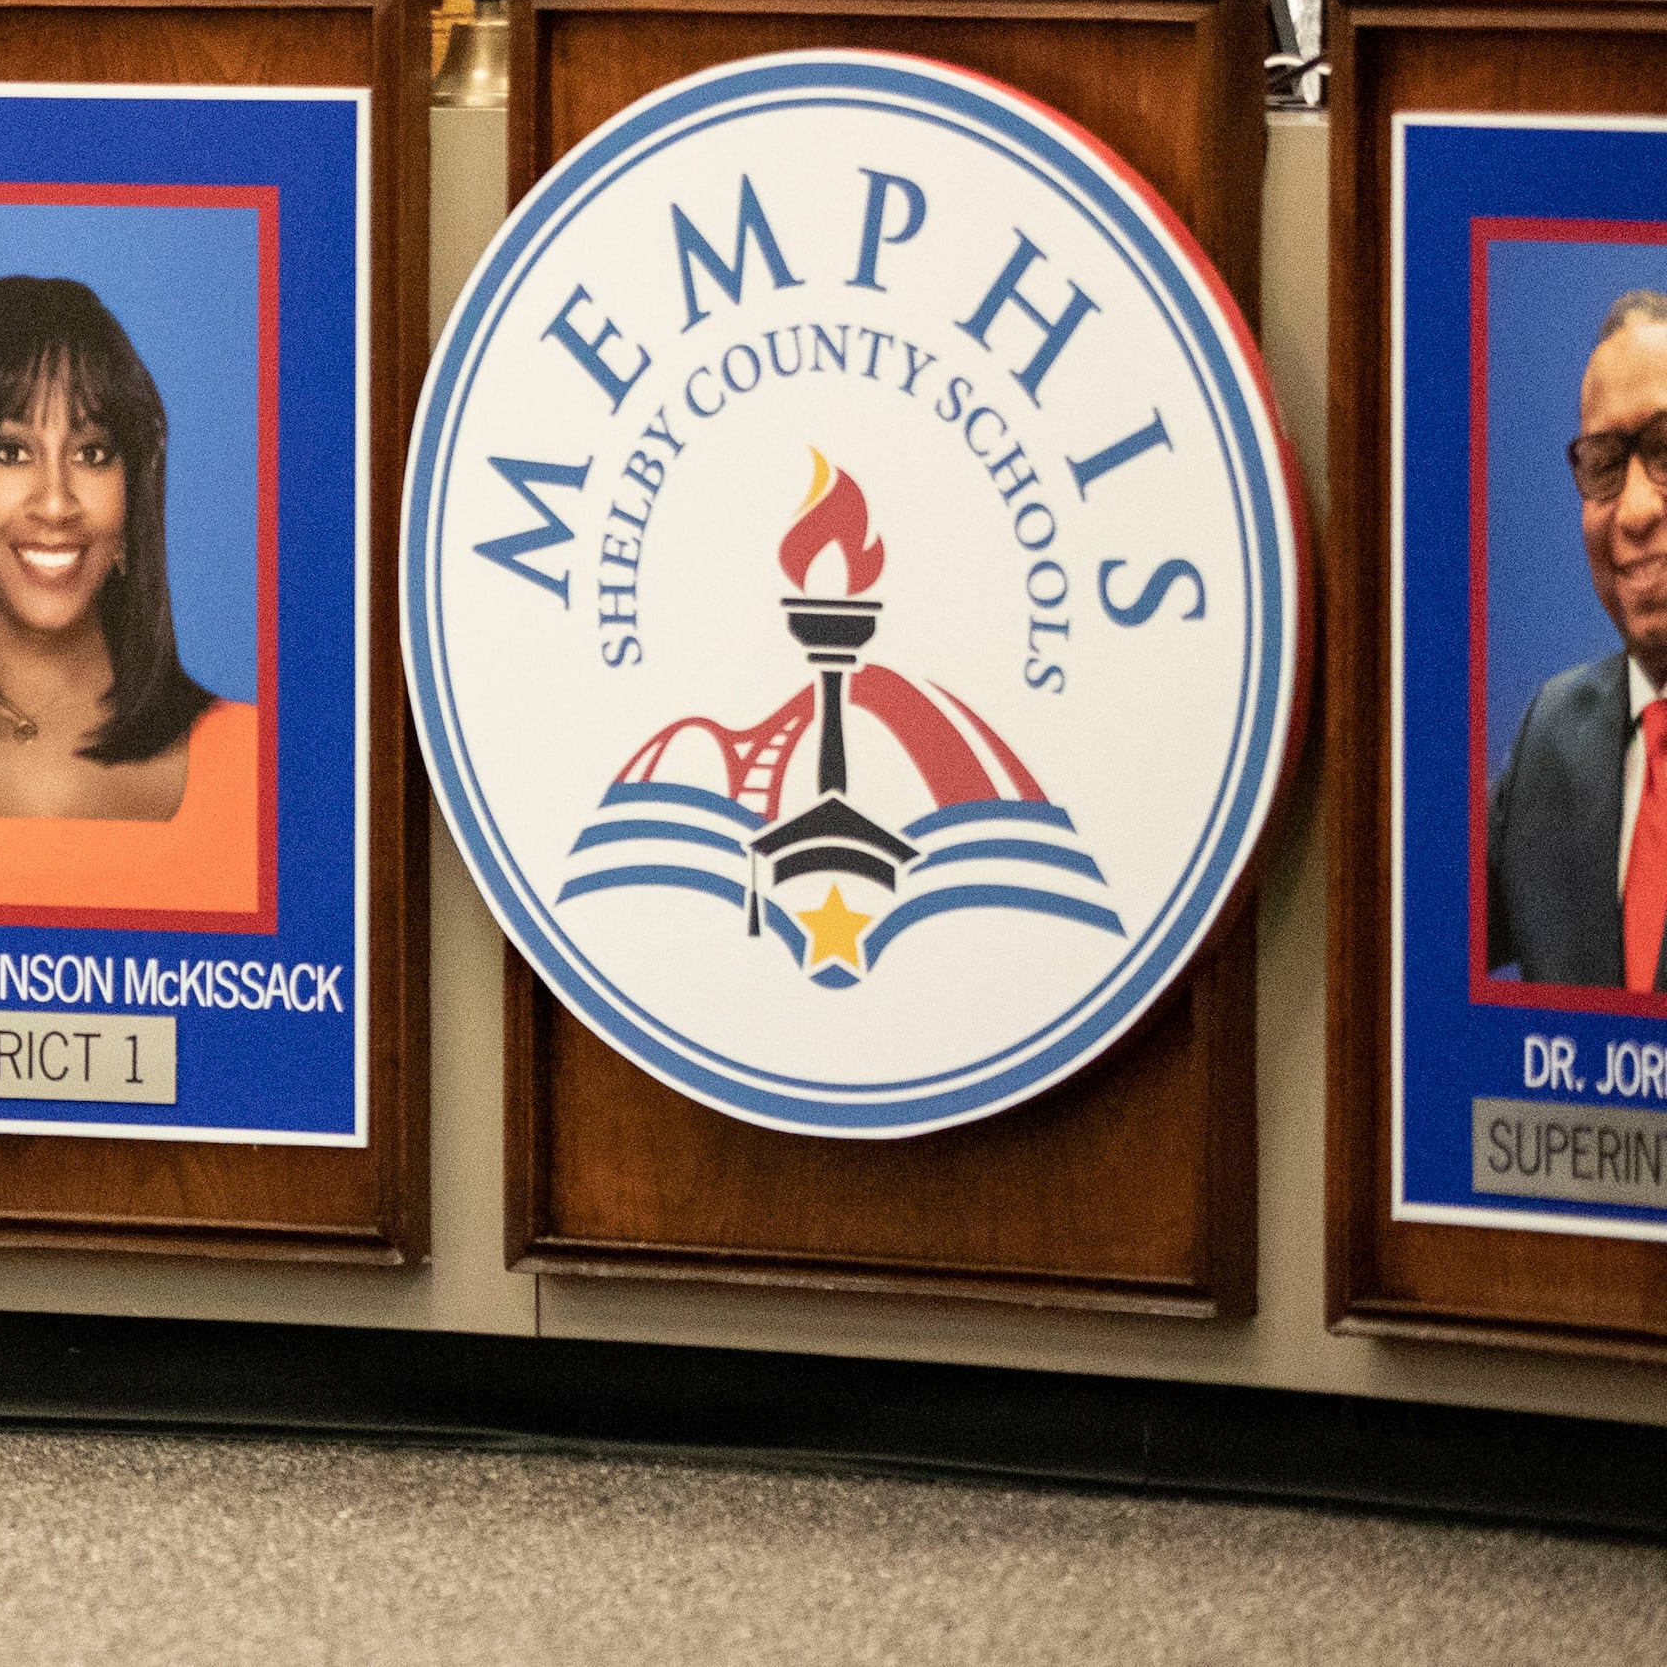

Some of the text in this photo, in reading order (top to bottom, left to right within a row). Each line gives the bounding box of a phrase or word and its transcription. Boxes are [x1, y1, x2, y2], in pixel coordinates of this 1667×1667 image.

[470, 166, 1208, 630] MEMPHIS
[597, 322, 1073, 696] SHELBY COUNTY SCHOOLS
[124, 957, 344, 1014] McKISSACK
[124, 1034, 145, 1086] 1
[1523, 1033, 1586, 1092] DR.
